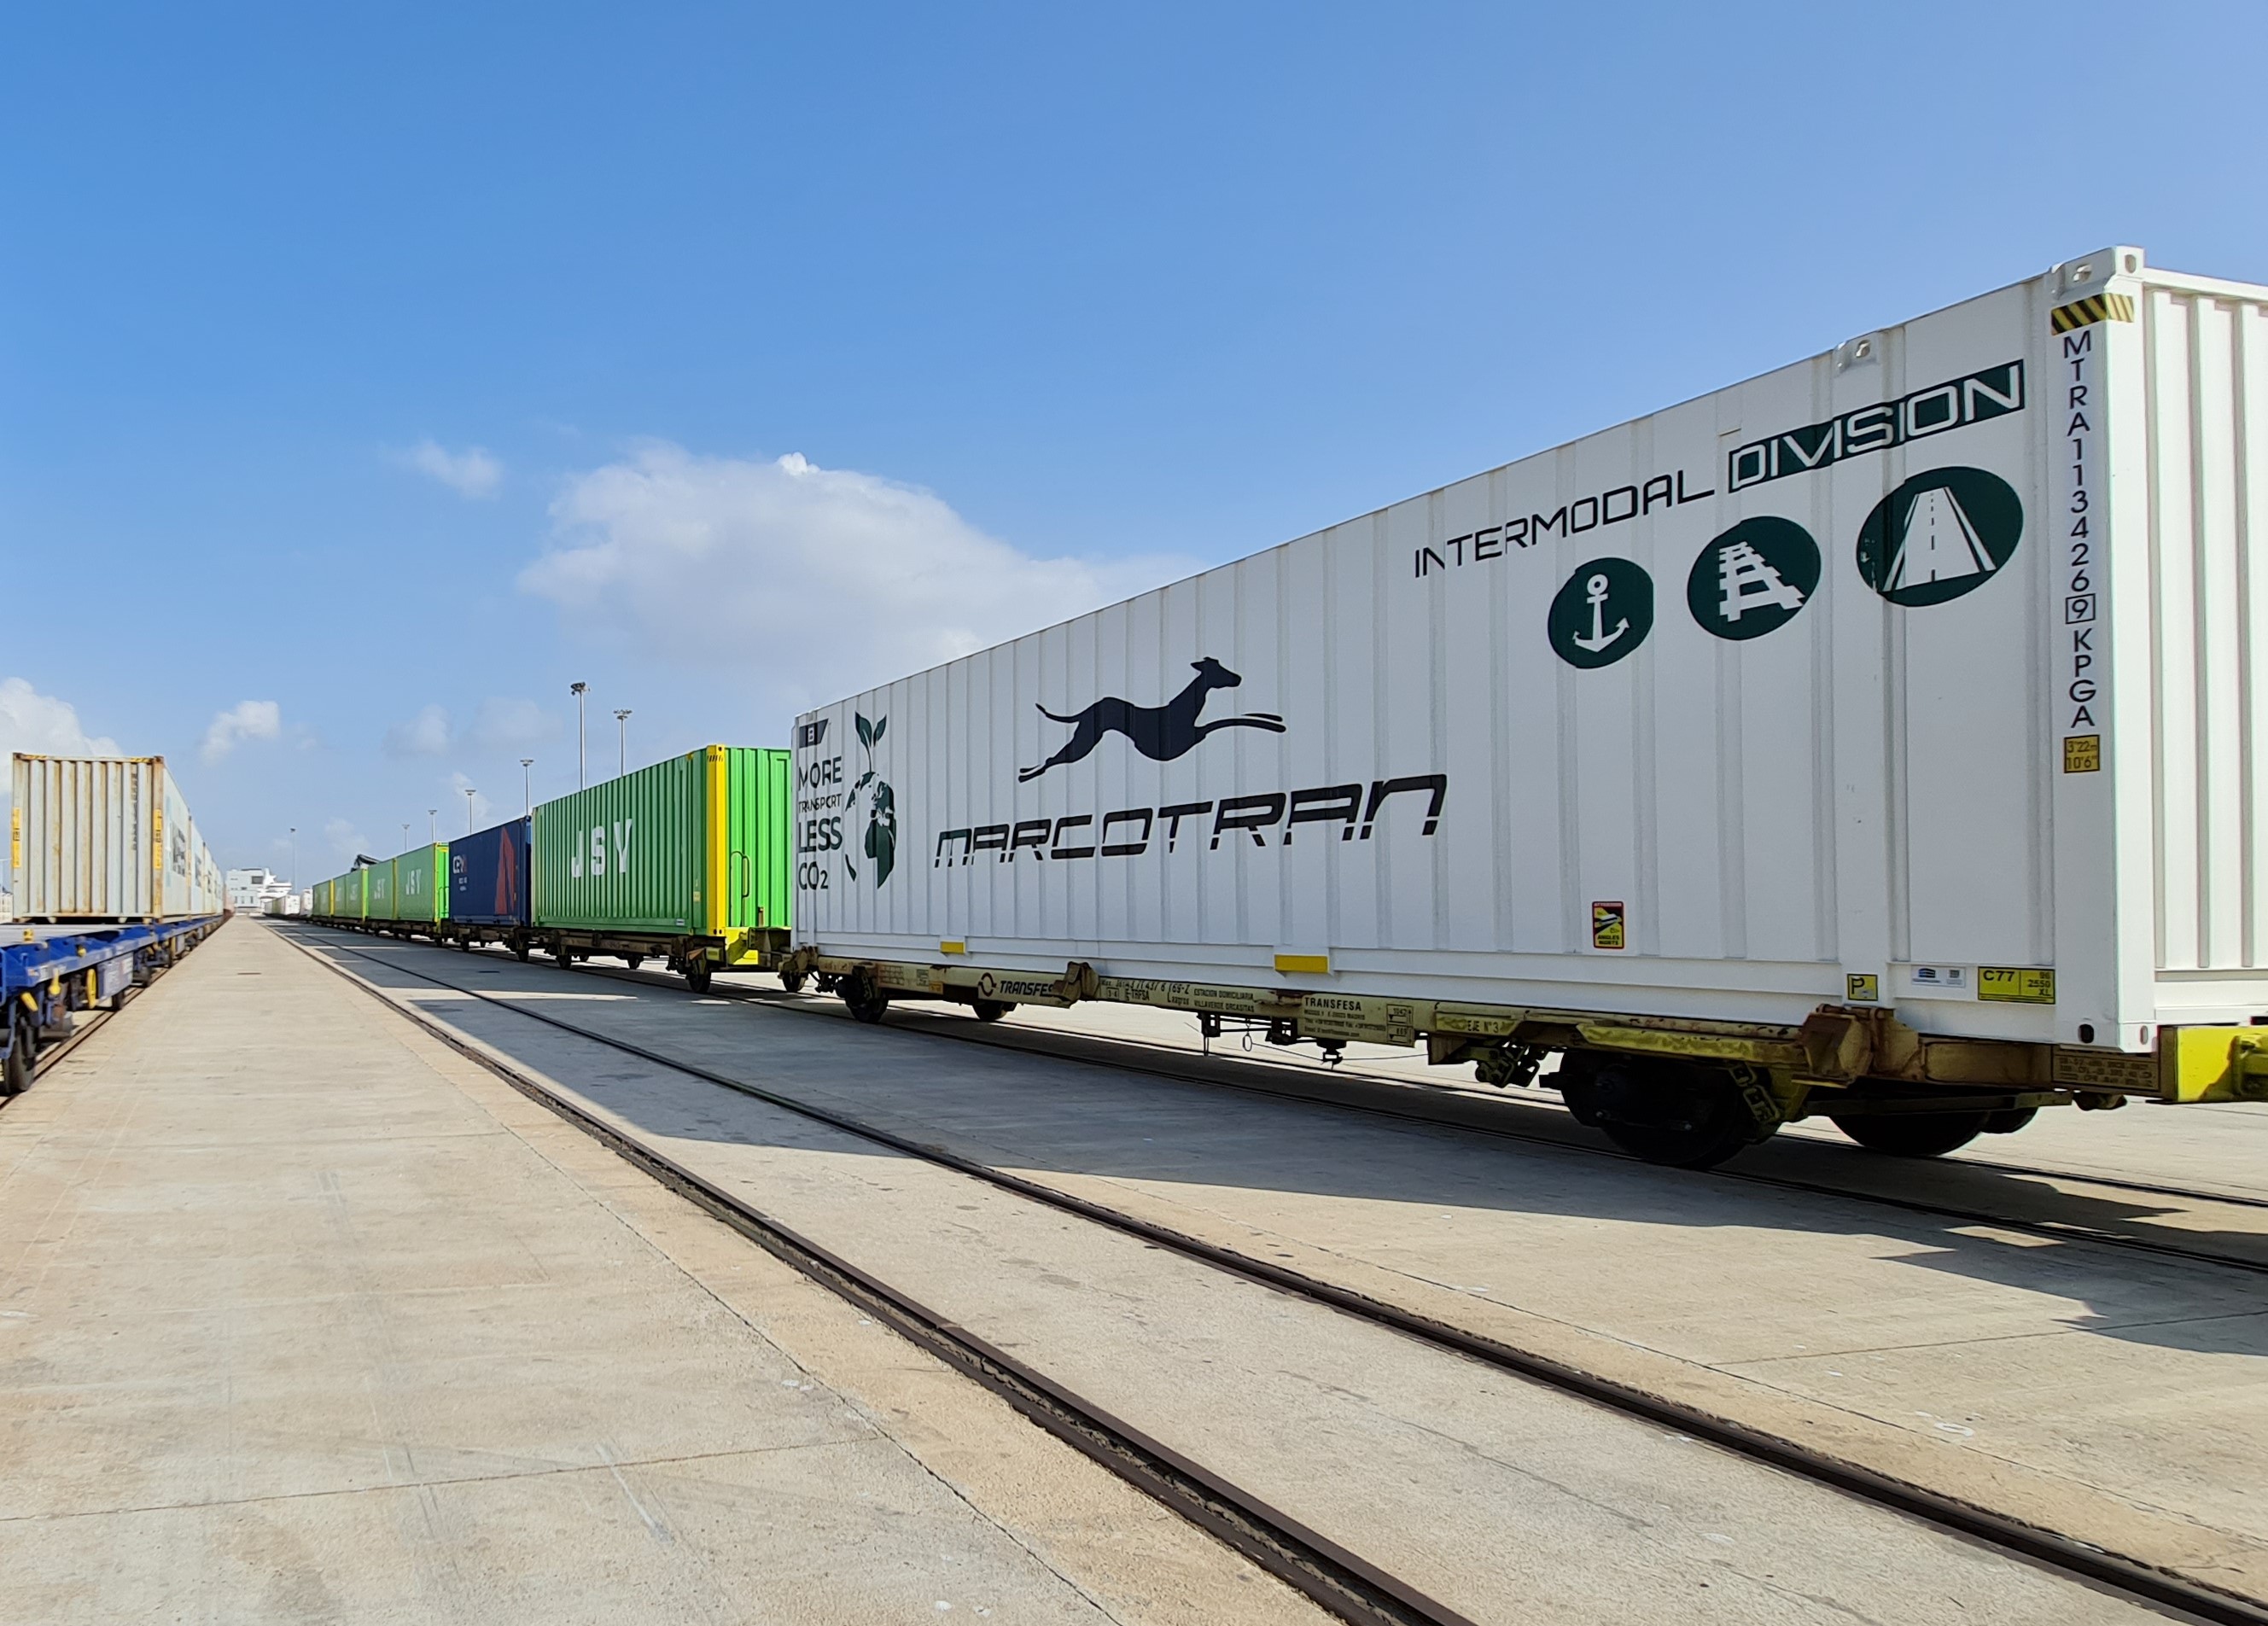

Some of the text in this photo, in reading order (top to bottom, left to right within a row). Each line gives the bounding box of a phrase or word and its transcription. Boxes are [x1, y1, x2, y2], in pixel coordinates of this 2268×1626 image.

[1414, 364, 2020, 579] INTERMODAL DIVISION
[798, 756, 842, 791] MORE
[798, 793, 842, 813] TRANSPORT
[934, 773, 1448, 868] MARCOTRAN
[570, 818, 633, 879] JSY
[798, 816, 843, 854] LESS
[1000, 980, 1056, 998] TRANSFES
[1851, 976, 1865, 995] P
[1983, 970, 2015, 982] C77
[1304, 997, 1362, 1011] TRANSFESA
